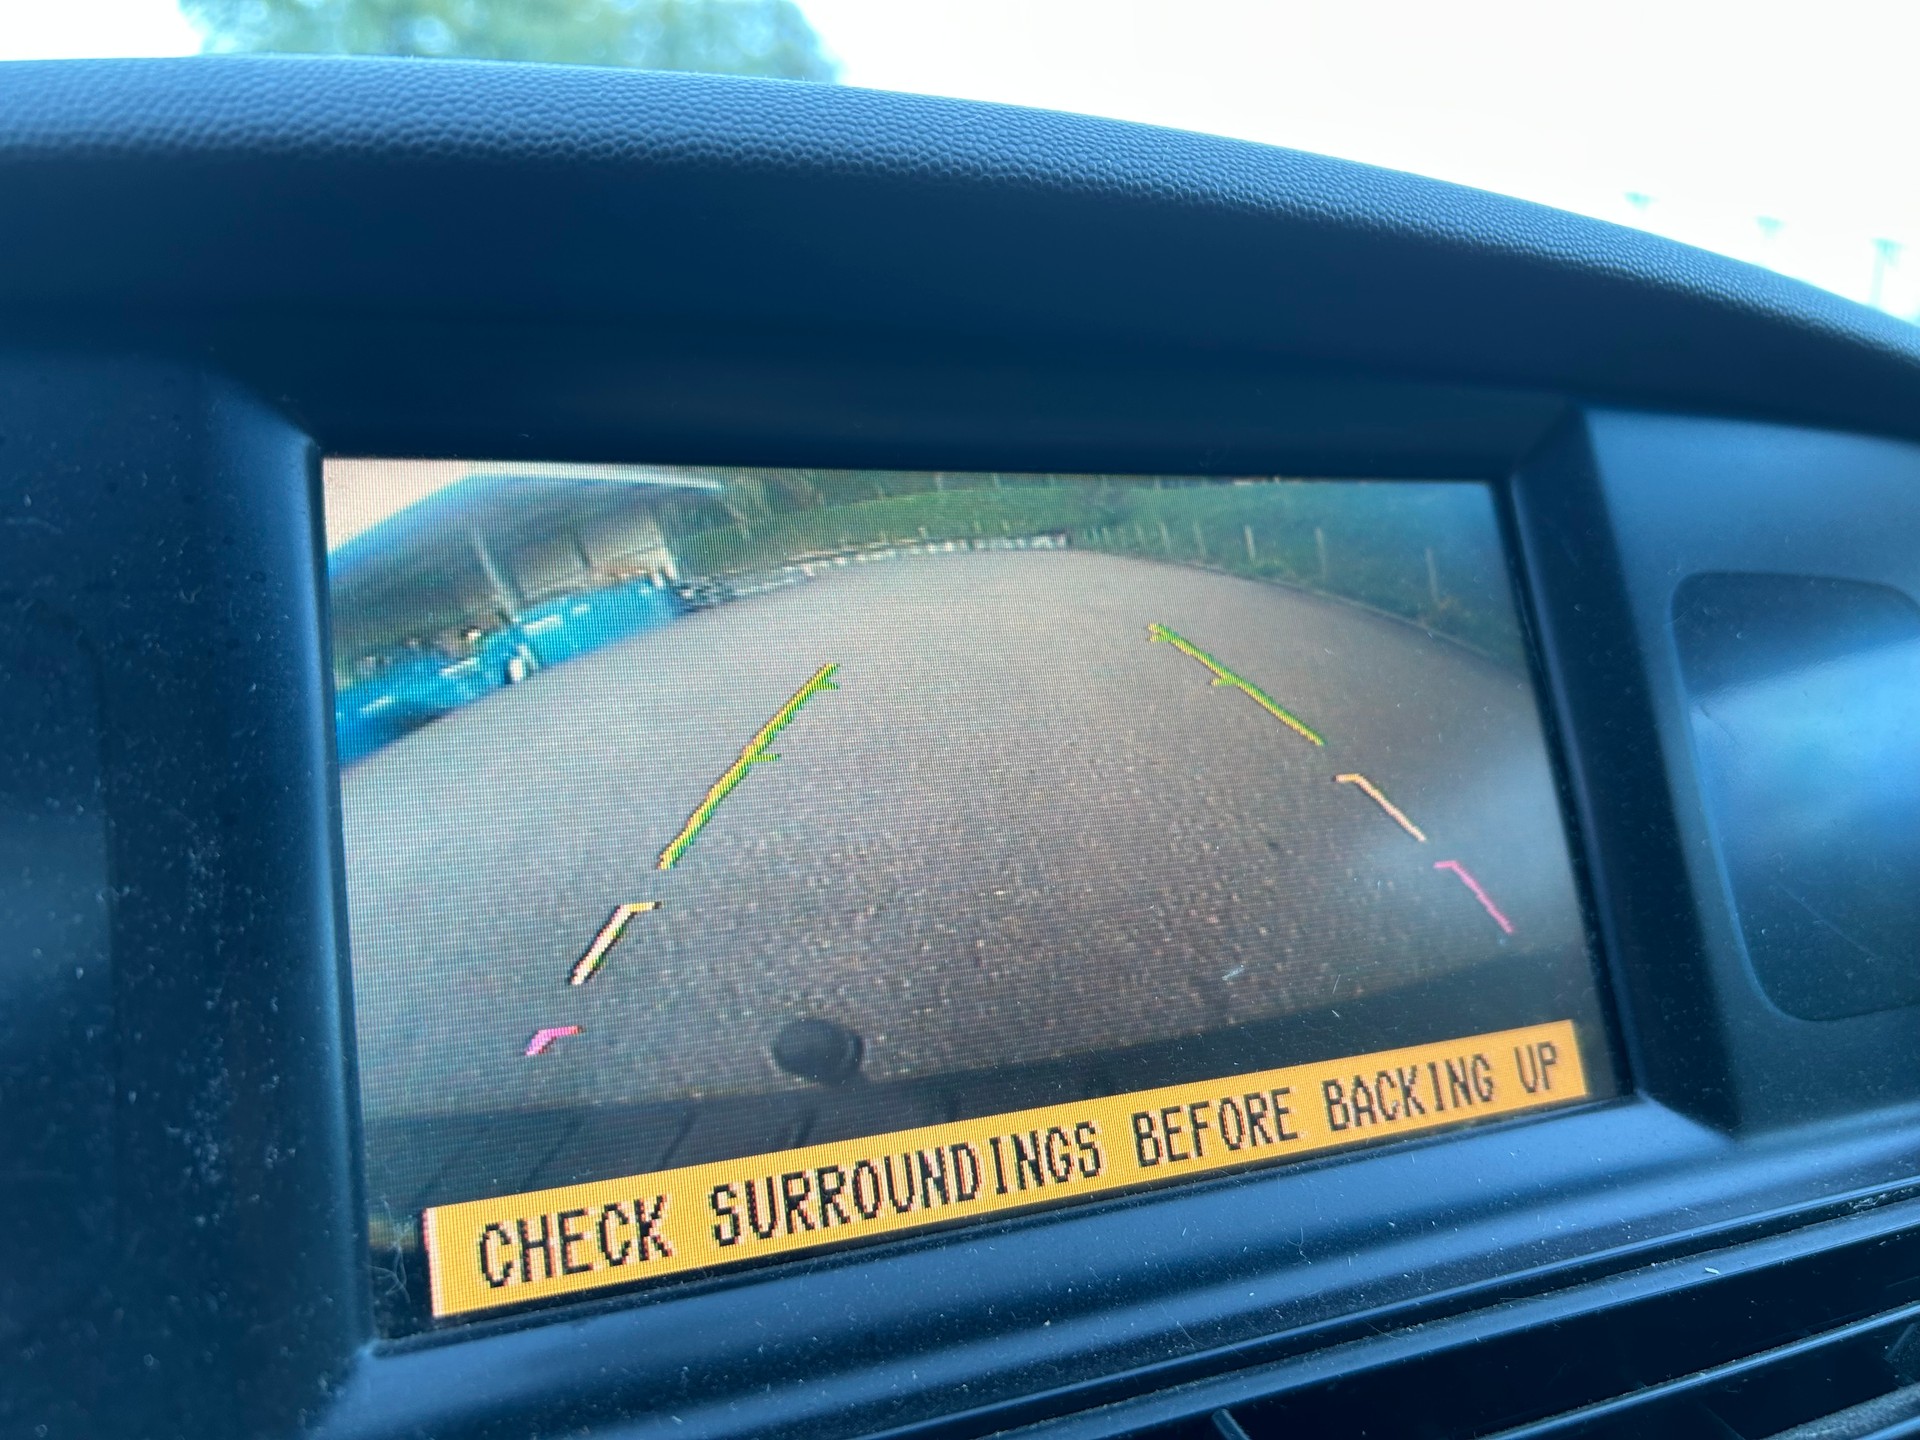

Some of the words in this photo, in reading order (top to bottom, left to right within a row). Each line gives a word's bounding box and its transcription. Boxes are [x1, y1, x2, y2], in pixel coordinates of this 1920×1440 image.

[479, 1194, 673, 1288] CHECK
[711, 1121, 1103, 1247] SURROUNDINGS
[1132, 1088, 1297, 1167] BEFORE
[1323, 1053, 1494, 1131] BACKING
[1515, 1042, 1559, 1094] UP
